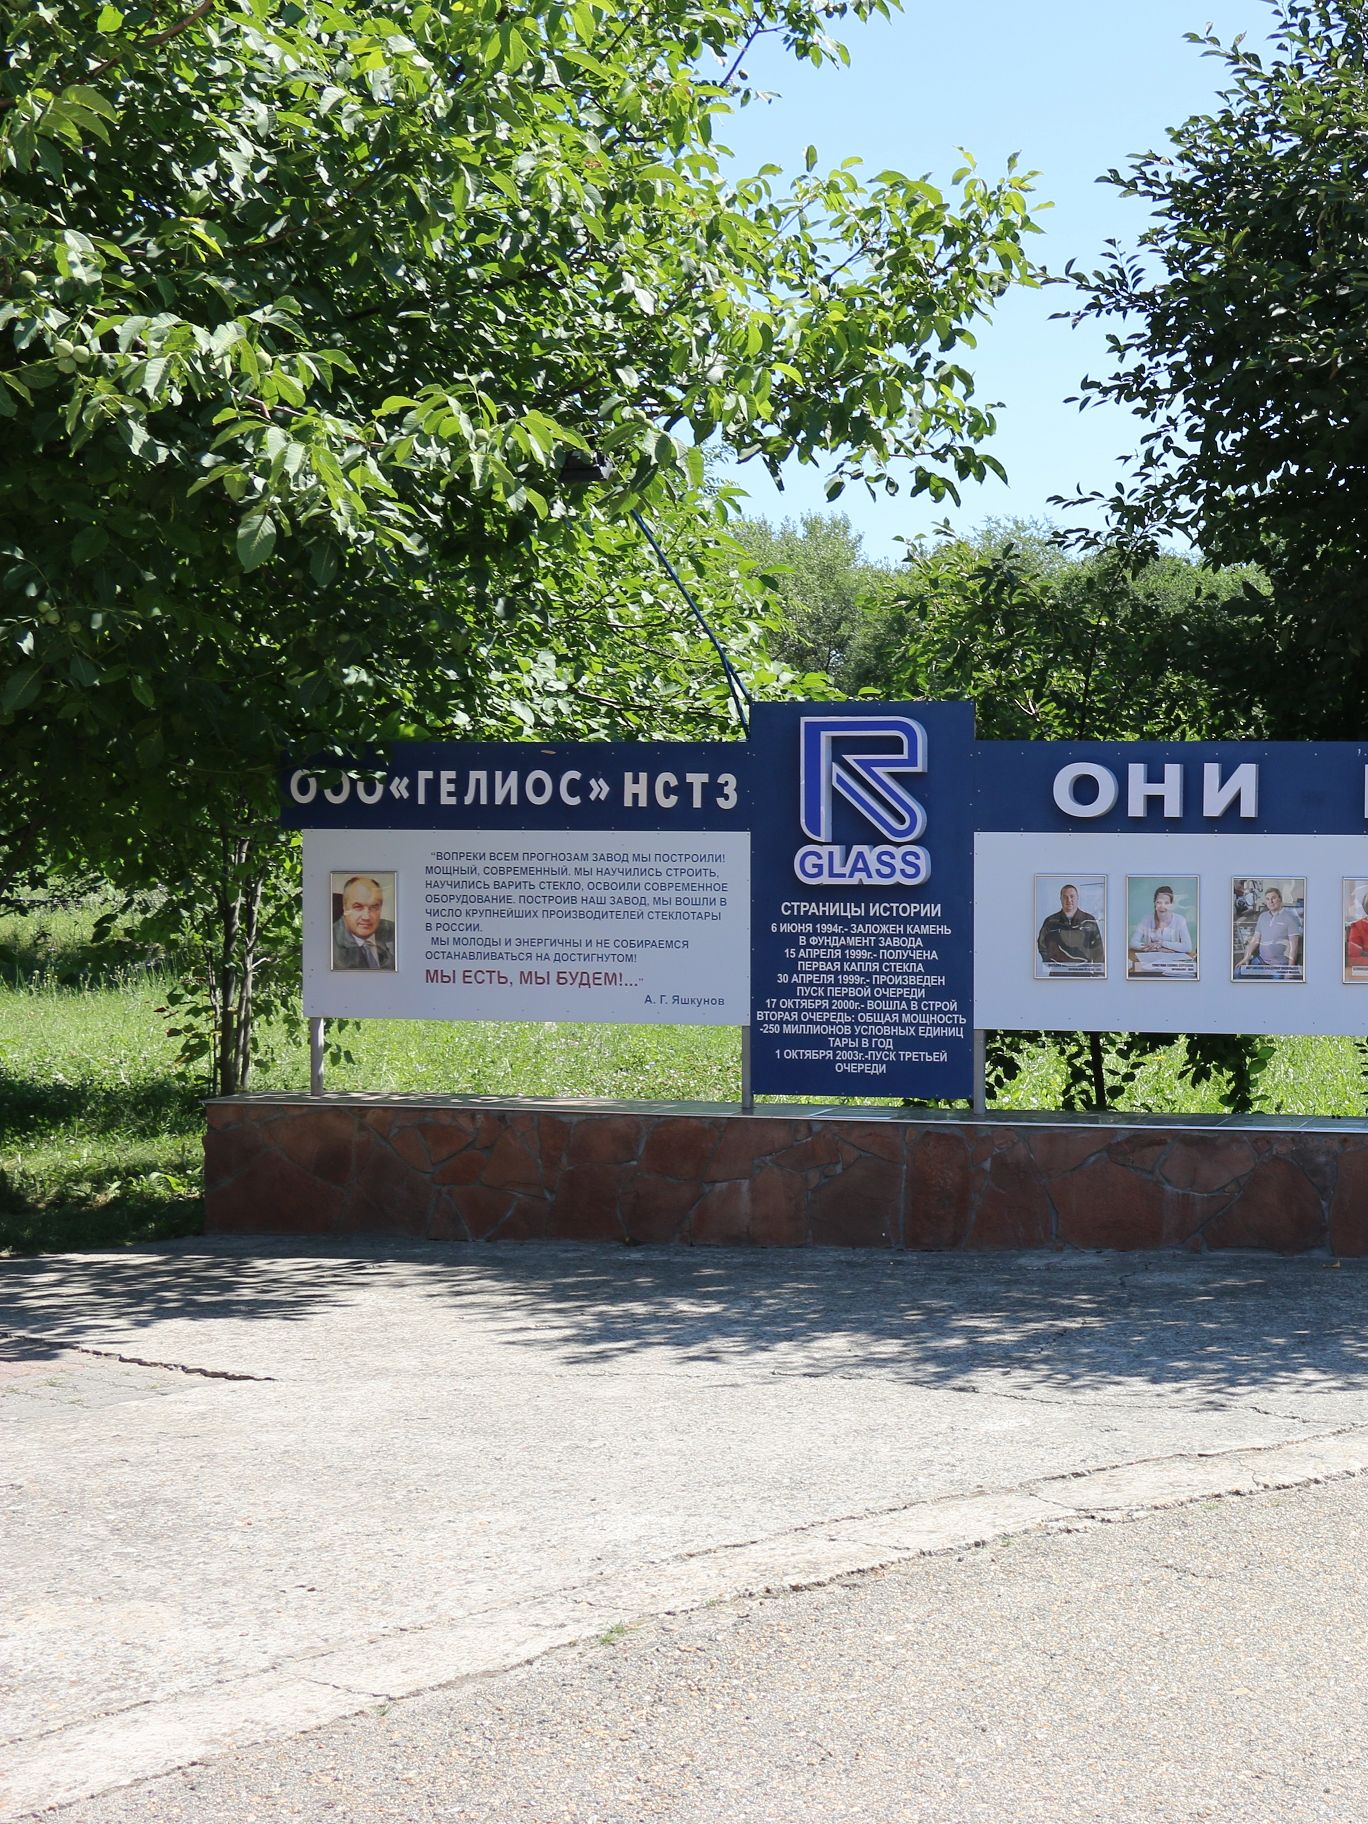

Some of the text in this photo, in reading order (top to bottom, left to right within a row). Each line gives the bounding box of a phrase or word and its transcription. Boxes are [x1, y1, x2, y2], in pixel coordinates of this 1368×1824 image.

[623, 772, 738, 809] НСТЗ
[1052, 762, 1260, 818] ОНИ
[489, 852, 519, 861] ВСЕМ
[522, 852, 589, 862] ПРОГНОЗАМ
[592, 853, 629, 863] ЗАВОД
[632, 853, 651, 863] МЫ
[654, 853, 726, 863] ПОСТРОИЛИ!
[798, 848, 925, 881] GLASS
[425, 865, 480, 876] МОЩНЫЙ,
[574, 867, 593, 876] МЫ
[596, 867, 663, 877] НАУЧИЛИСЬ
[665, 868, 719, 879] СТРОИТЬ,
[425, 880, 729, 892] НАУЧИЛИСЬ ВАРИТЬ СТЕКЛО, ОСВОИЛИ СОВРЕМЕННОЕ
[518, 895, 578, 905] ПОСТРОИВ
[581, 896, 606, 905] НАШ
[652, 896, 672, 906] МЫ
[675, 897, 716, 906] ВОШЛИ
[719, 897, 727, 907] В
[425, 907, 722, 921] ЧИСЛО КРУПНЕЙШИХ ПРОИЗВОДИТЕЛЕЙ СТЕКЛОТАРЫ
[781, 902, 942, 918] СТРАНИЦЫ ИСТОРИИ
[425, 923, 483, 932] В РОССИИ.
[771, 923, 778, 933] 6
[780, 923, 813, 933] ИЮНЯ
[850, 924, 904, 934] ЗАЛОЖЕН
[906, 924, 952, 935] КАМЕНЬ
[431, 936, 689, 949] МЫ МОЛОДЫ И ЭНЕРГИЧНЫ И НЕ СОБИРАЕМСЯ
[799, 935, 924, 948] В ФУНДАМЕНТ ЗАВОДА
[425, 950, 637, 963] ОСТАНАВЛИВАТЬСЯ НА ДОСТИГНУТОМ!
[784, 948, 796, 958] 15
[798, 949, 842, 959] АПРЕЛЯ
[879, 950, 939, 960] ПОЛУЧЕНА
[797, 961, 925, 973] ПЕРВАЯ КАПЛЯ СТЕКЛА
[425, 969, 456, 984] МЫ
[462, 969, 513, 986] ЕСТЬ,
[519, 970, 550, 985] МЫ
[777, 973, 789, 984] 30
[791, 974, 835, 984] АПРЕЛЯ
[872, 974, 946, 987] ПРОИЗВЕДЕН
[796, 985, 926, 999] ПУСК ПЕРВОЙ ОЧЕРЕДИ
[644, 995, 725, 1007] А. Г. Яшкунов
[766, 999, 777, 1009] 17
[779, 999, 829, 1009] ОКТЯБРЯ
[867, 1000, 908, 1011] ВОШЛА
[910, 1000, 918, 1011] В
[921, 999, 958, 1011] СТРОЙ
[756, 1011, 967, 1025] ВТОРАЯ ОЧЕРЕДЬ: ОБЩАЯ МОЩНОСТЬ
[782, 1024, 852, 1035] МИЛЛИОНОВ
[854, 1025, 916, 1036] УСЛОВНЫХ
[918, 1026, 964, 1038] ЕДИНИЦ
[828, 1037, 894, 1050] ТАРЫ В ГОД
[775, 1049, 780, 1059] 1
[783, 1049, 833, 1060] ОКТЯБРЯ
[898, 1050, 948, 1062] ТРЕТЬЕЙ
[835, 1062, 887, 1075] ОЧЕРЕДИ
